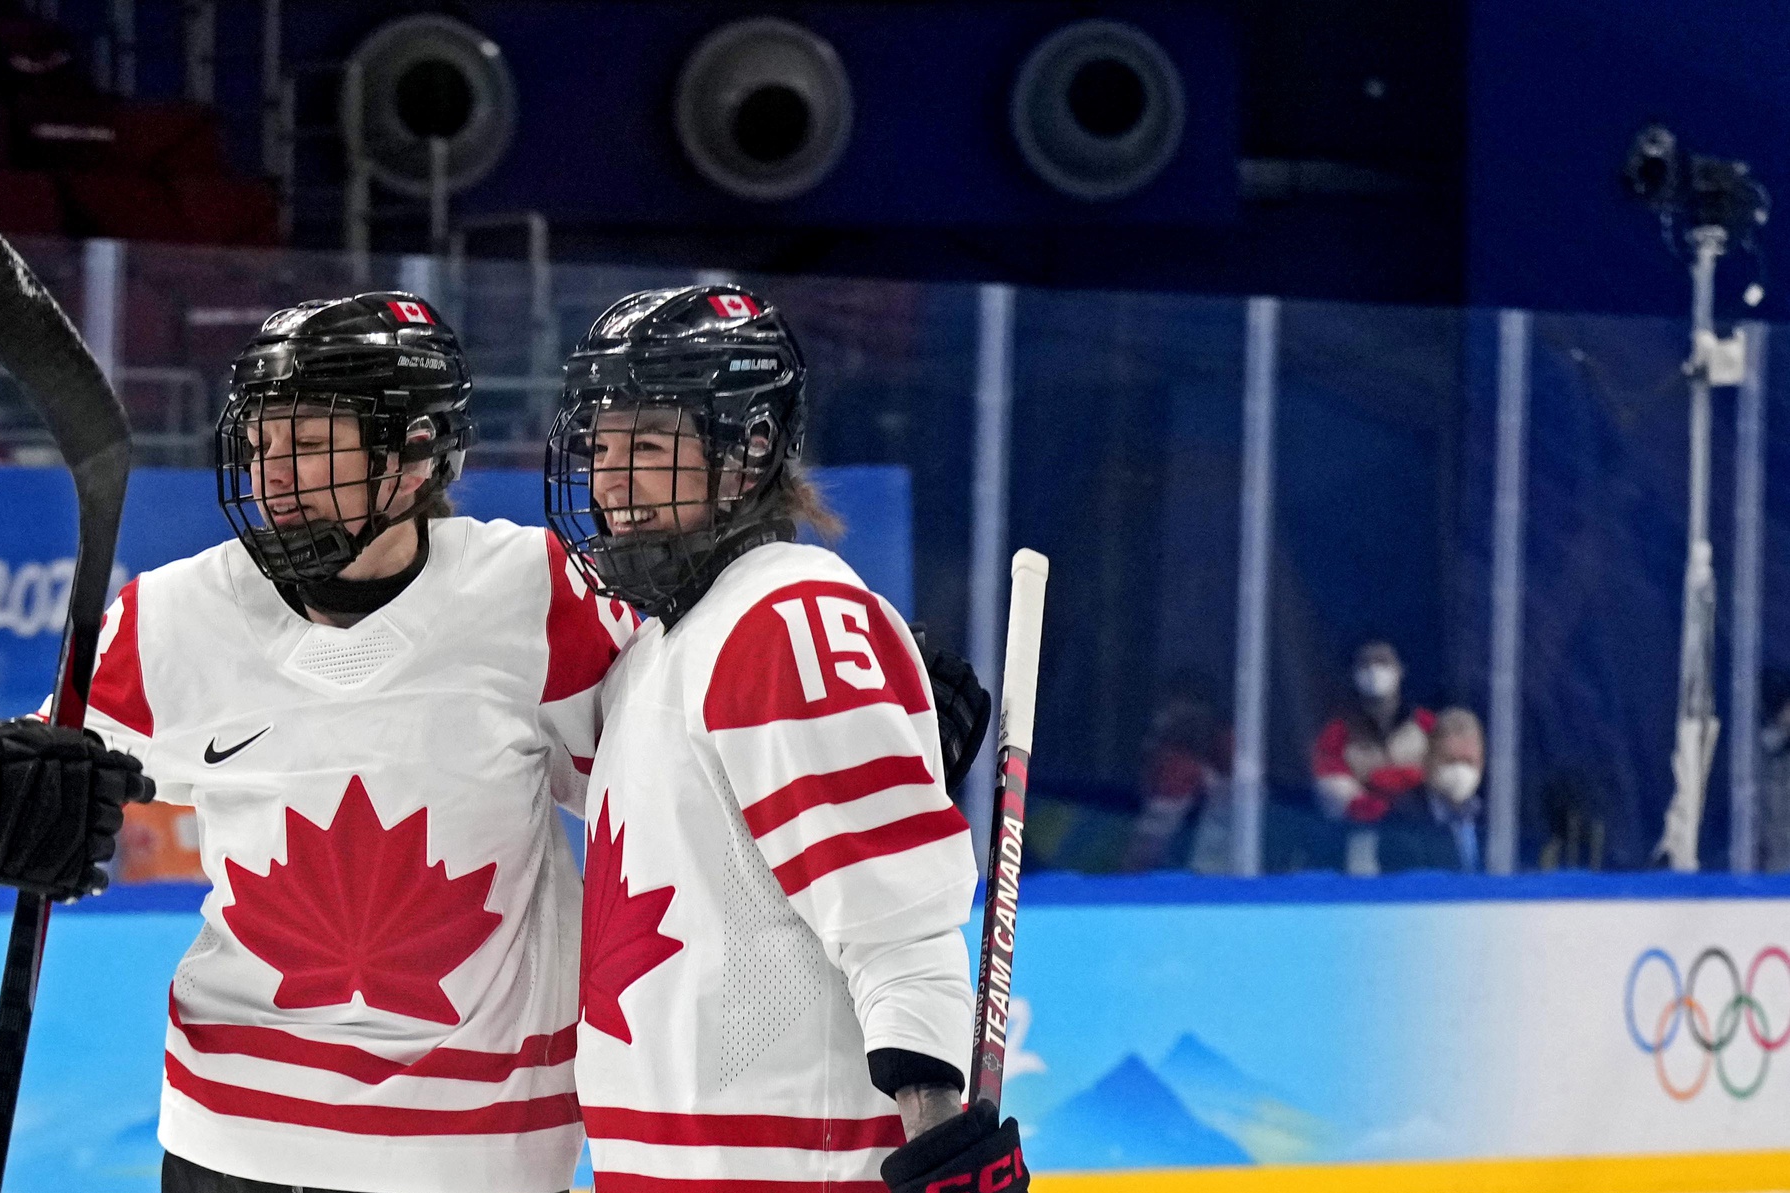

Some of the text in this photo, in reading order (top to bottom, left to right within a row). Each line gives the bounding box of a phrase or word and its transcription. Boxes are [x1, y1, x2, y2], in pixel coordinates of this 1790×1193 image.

[771, 595, 887, 704] 15
[985, 815, 1025, 1049] TEAM CANADA
